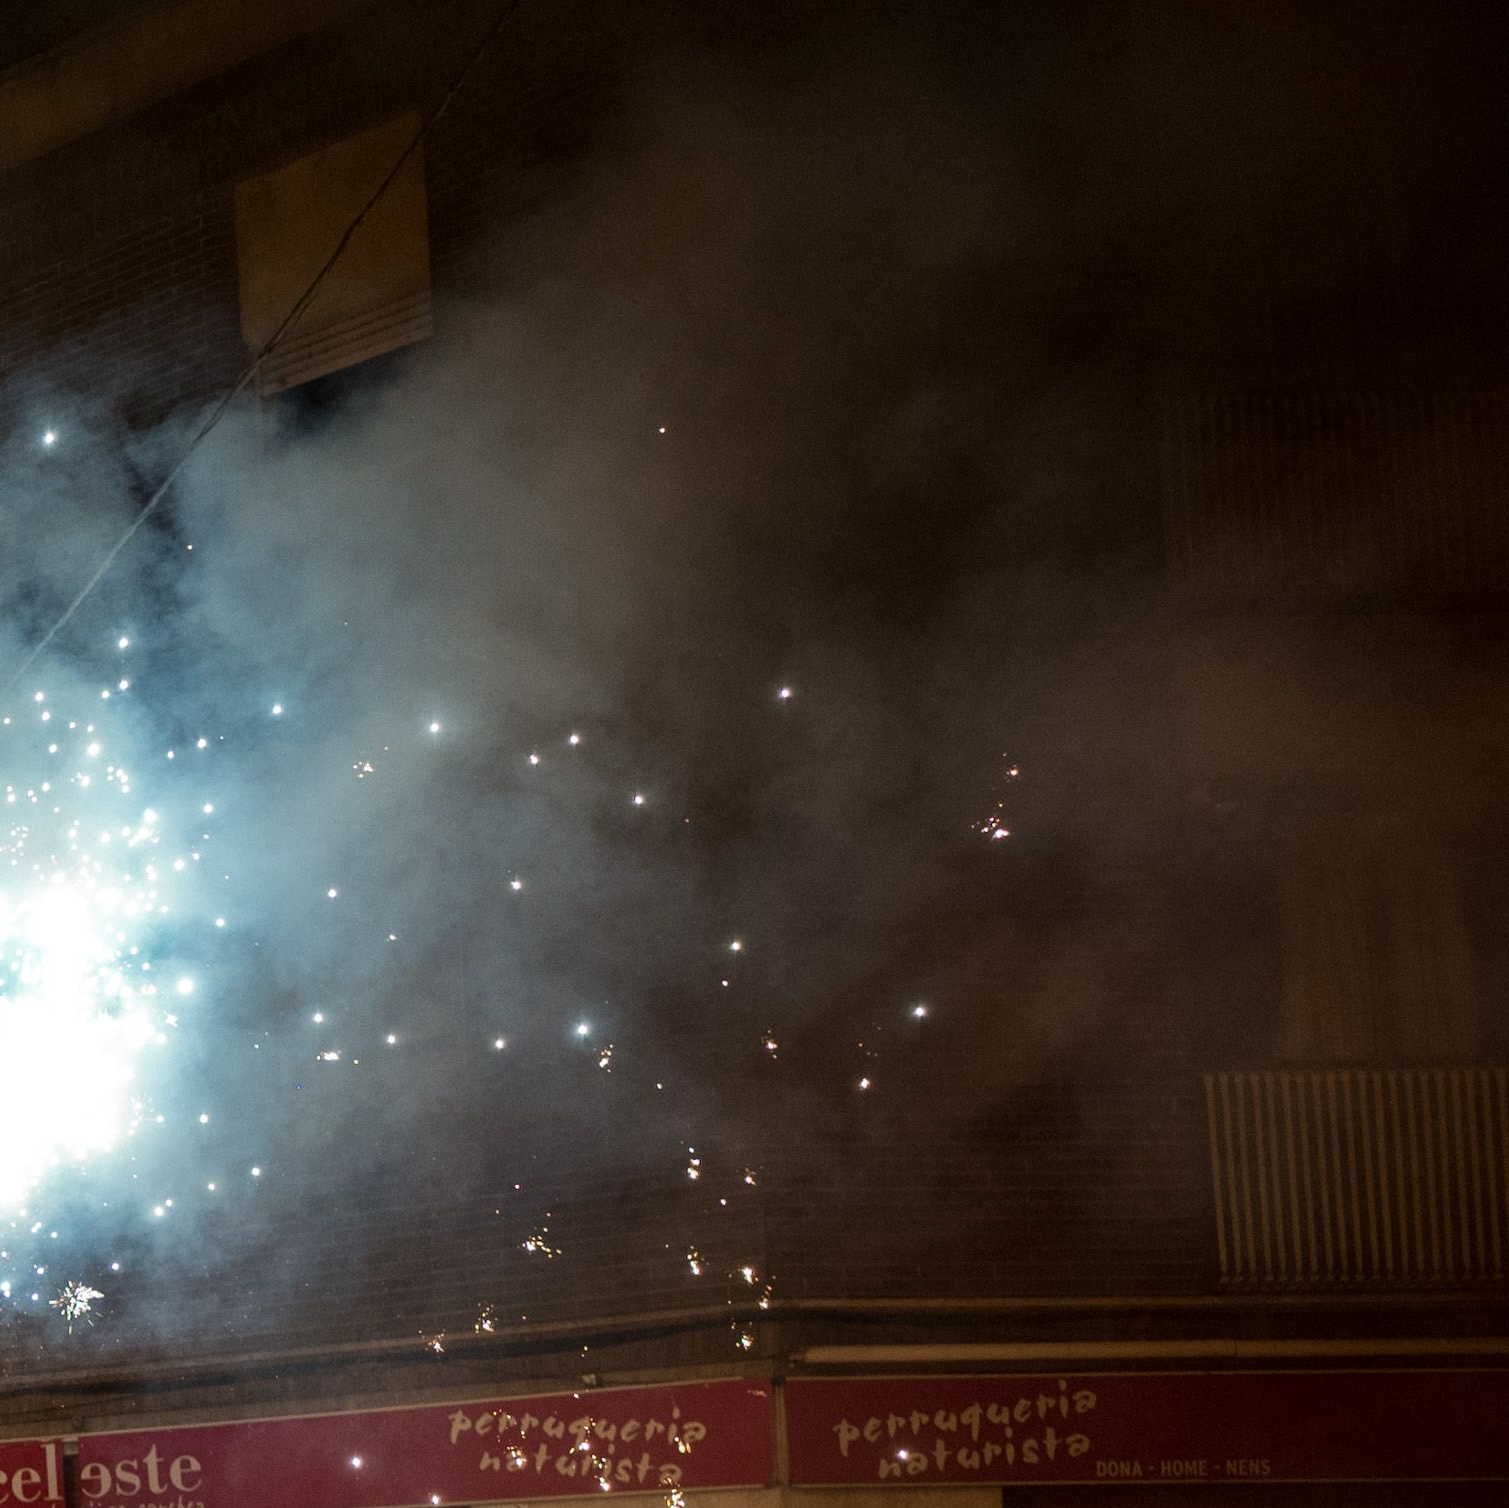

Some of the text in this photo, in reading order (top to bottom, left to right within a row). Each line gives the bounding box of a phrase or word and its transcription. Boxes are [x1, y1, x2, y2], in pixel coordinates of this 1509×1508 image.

[448, 1406, 708, 1448] perruqueria
[832, 1379, 1097, 1457] perruqueria
[479, 1443, 682, 1484] naturista
[878, 1426, 1091, 1479] naturista
[1096, 1459, 1143, 1477] DONA
[1160, 1459, 1208, 1476] HOME
[1226, 1458, 1271, 1476] NENS
